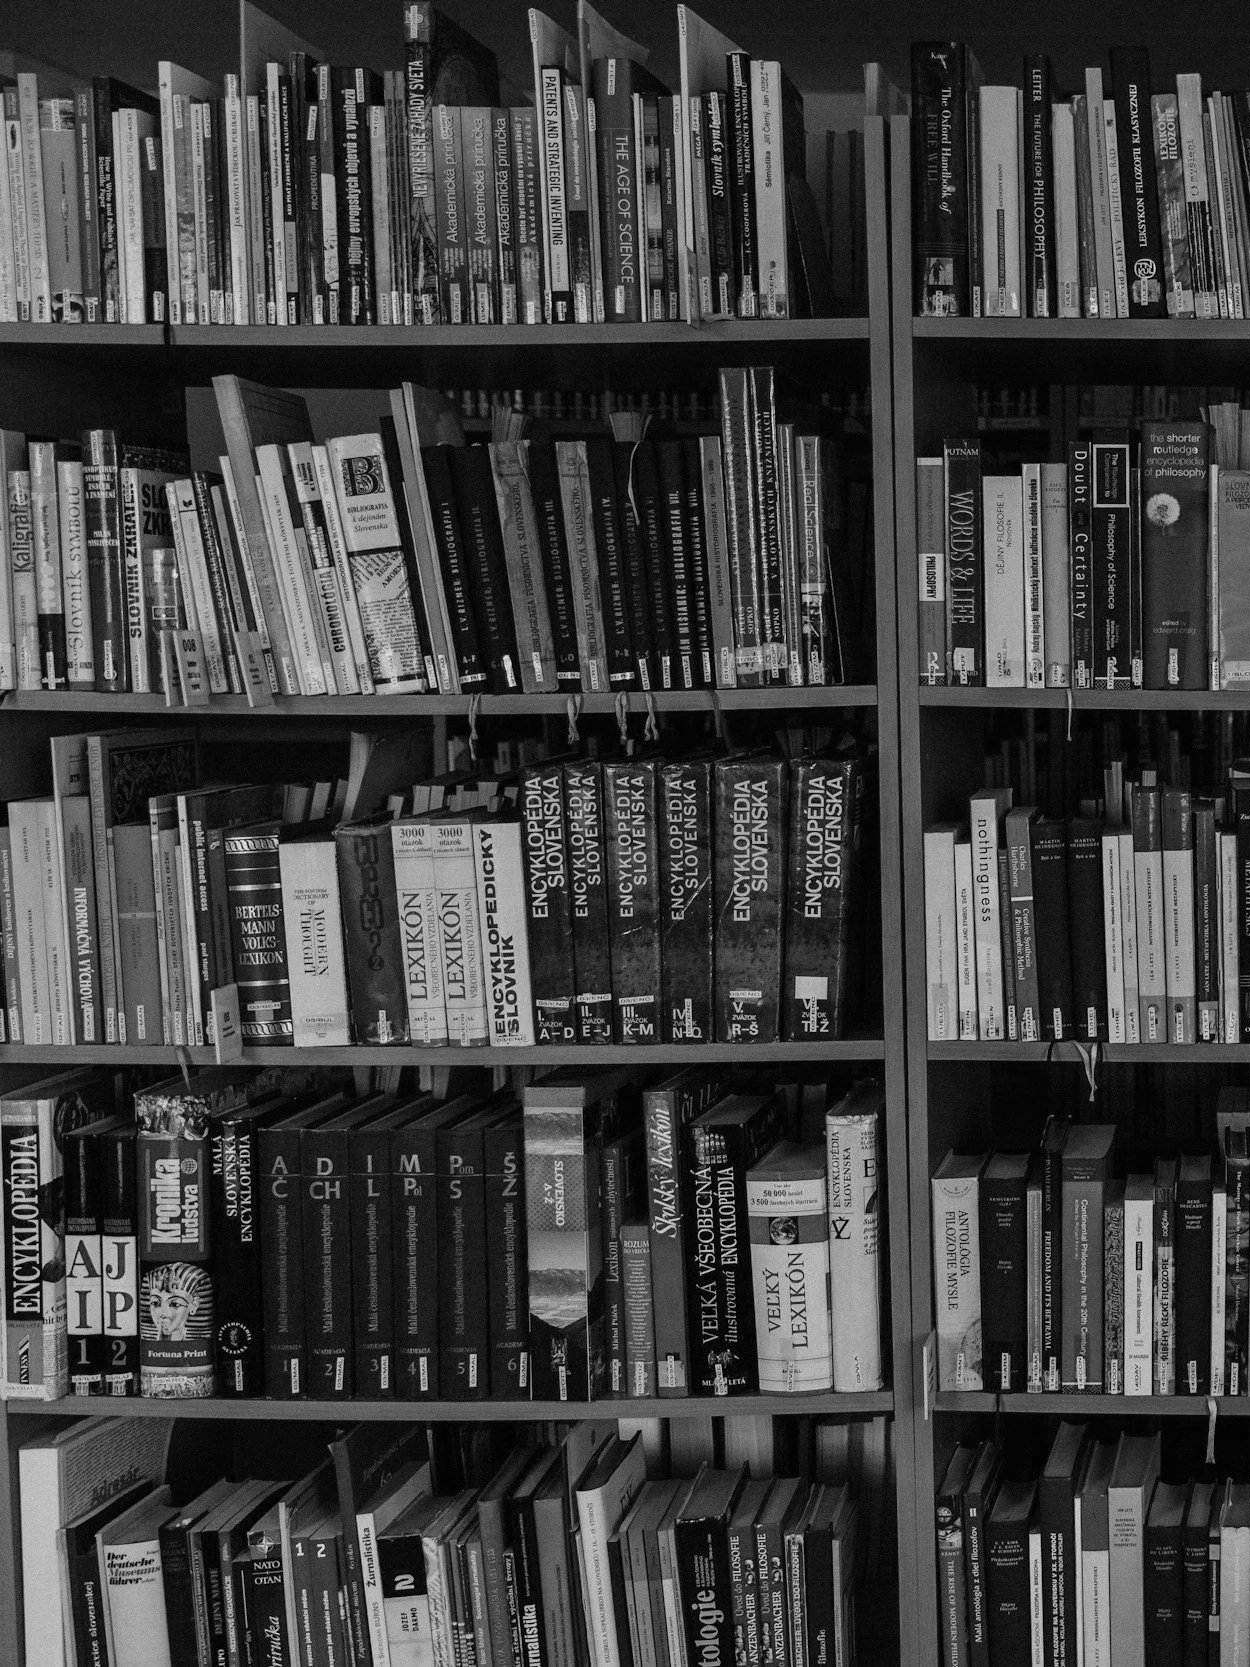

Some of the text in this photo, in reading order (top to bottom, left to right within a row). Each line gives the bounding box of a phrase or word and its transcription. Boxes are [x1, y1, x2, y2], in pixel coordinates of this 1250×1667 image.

[341, 89, 357, 130] vynálezů
[408, 61, 428, 198] NEVYRIEŠENÉ ZÁHADY SVETA
[1032, 69, 1042, 101] LEITER
[343, 142, 358, 174] objevů
[544, 76, 564, 245] PATENTS AND STRATEGIC INVENTING
[940, 88, 952, 214] The Oxford Handbook of
[1033, 114, 1045, 260] THE FUTURE FOR PHILOSOPHY
[1129, 84, 1147, 247] LEKSYKON FILOZOFII KLASYCZNEJ
[345, 177, 361, 233] evropských
[348, 237, 362, 264] Dějiny
[616, 135, 634, 283] THE AGE OF SCIENCE
[65, 486, 83, 648] Slovník SYMBOLŮ
[926, 556, 936, 598] PHILOSOPHY
[950, 491, 975, 623] WORDS & LIFE
[1073, 450, 1088, 619] Doubt Certainty
[1106, 514, 1116, 609] Philosophy of Science
[319, 571, 347, 653] CHRONOLÓGIA
[524, 776, 549, 918] ENCYKLOPÉDIA
[543, 775, 565, 888] SLOVENSKA
[568, 775, 589, 917] ENCYKLOPÉDIA
[583, 775, 601, 885] SLOVENSKA
[616, 775, 634, 917] ENCYKLOPÉDIA
[632, 776, 647, 885] SLOVENSKA
[666, 780, 684, 920] ENCYKLOPÉDIA
[684, 779, 699, 889] SLOVENSKA
[976, 818, 992, 922] nothingness
[401, 892, 428, 1000] LEXIKÓN
[478, 829, 506, 1034] ENCYKLOPEDICKÝ
[151, 1158, 181, 1244] Kronika
[213, 1135, 223, 1175] MALÁ
[226, 1134, 238, 1217] SLOVENSKÁ
[239, 1134, 252, 1242] ENCYKLOPÉDIA
[649, 1108, 683, 1238] Školský lexikón
[5, 1133, 41, 1314] ENCYKLOPÉDIA
[181, 1184, 199, 1243] ľudstva
[689, 1167, 720, 1344] VEĽKÁ VŠEOBECNÁ
[717, 1167, 739, 1343] ilustrovaná ENCYKLOPÉDIA
[944, 1211, 958, 1310] FILOZOFIE MYSLE
[958, 1210, 970, 1275] ANTOLÓGIA
[762, 1267, 782, 1334] VEĽKÝ
[787, 1252, 809, 1349] LEXIKÓN
[253, 1559, 281, 1570] NATO
[253, 1574, 281, 1585] OTAN
[362, 1527, 377, 1588] Žurnalistika
[729, 1536, 742, 1582] FILOSOFIE
[970, 1527, 980, 1561] filozofov
[971, 1563, 979, 1577] diel
[745, 1593, 759, 1663] ANZENBACHER
[973, 1585, 983, 1622] antológia
[974, 1624, 982, 1642] Malá
